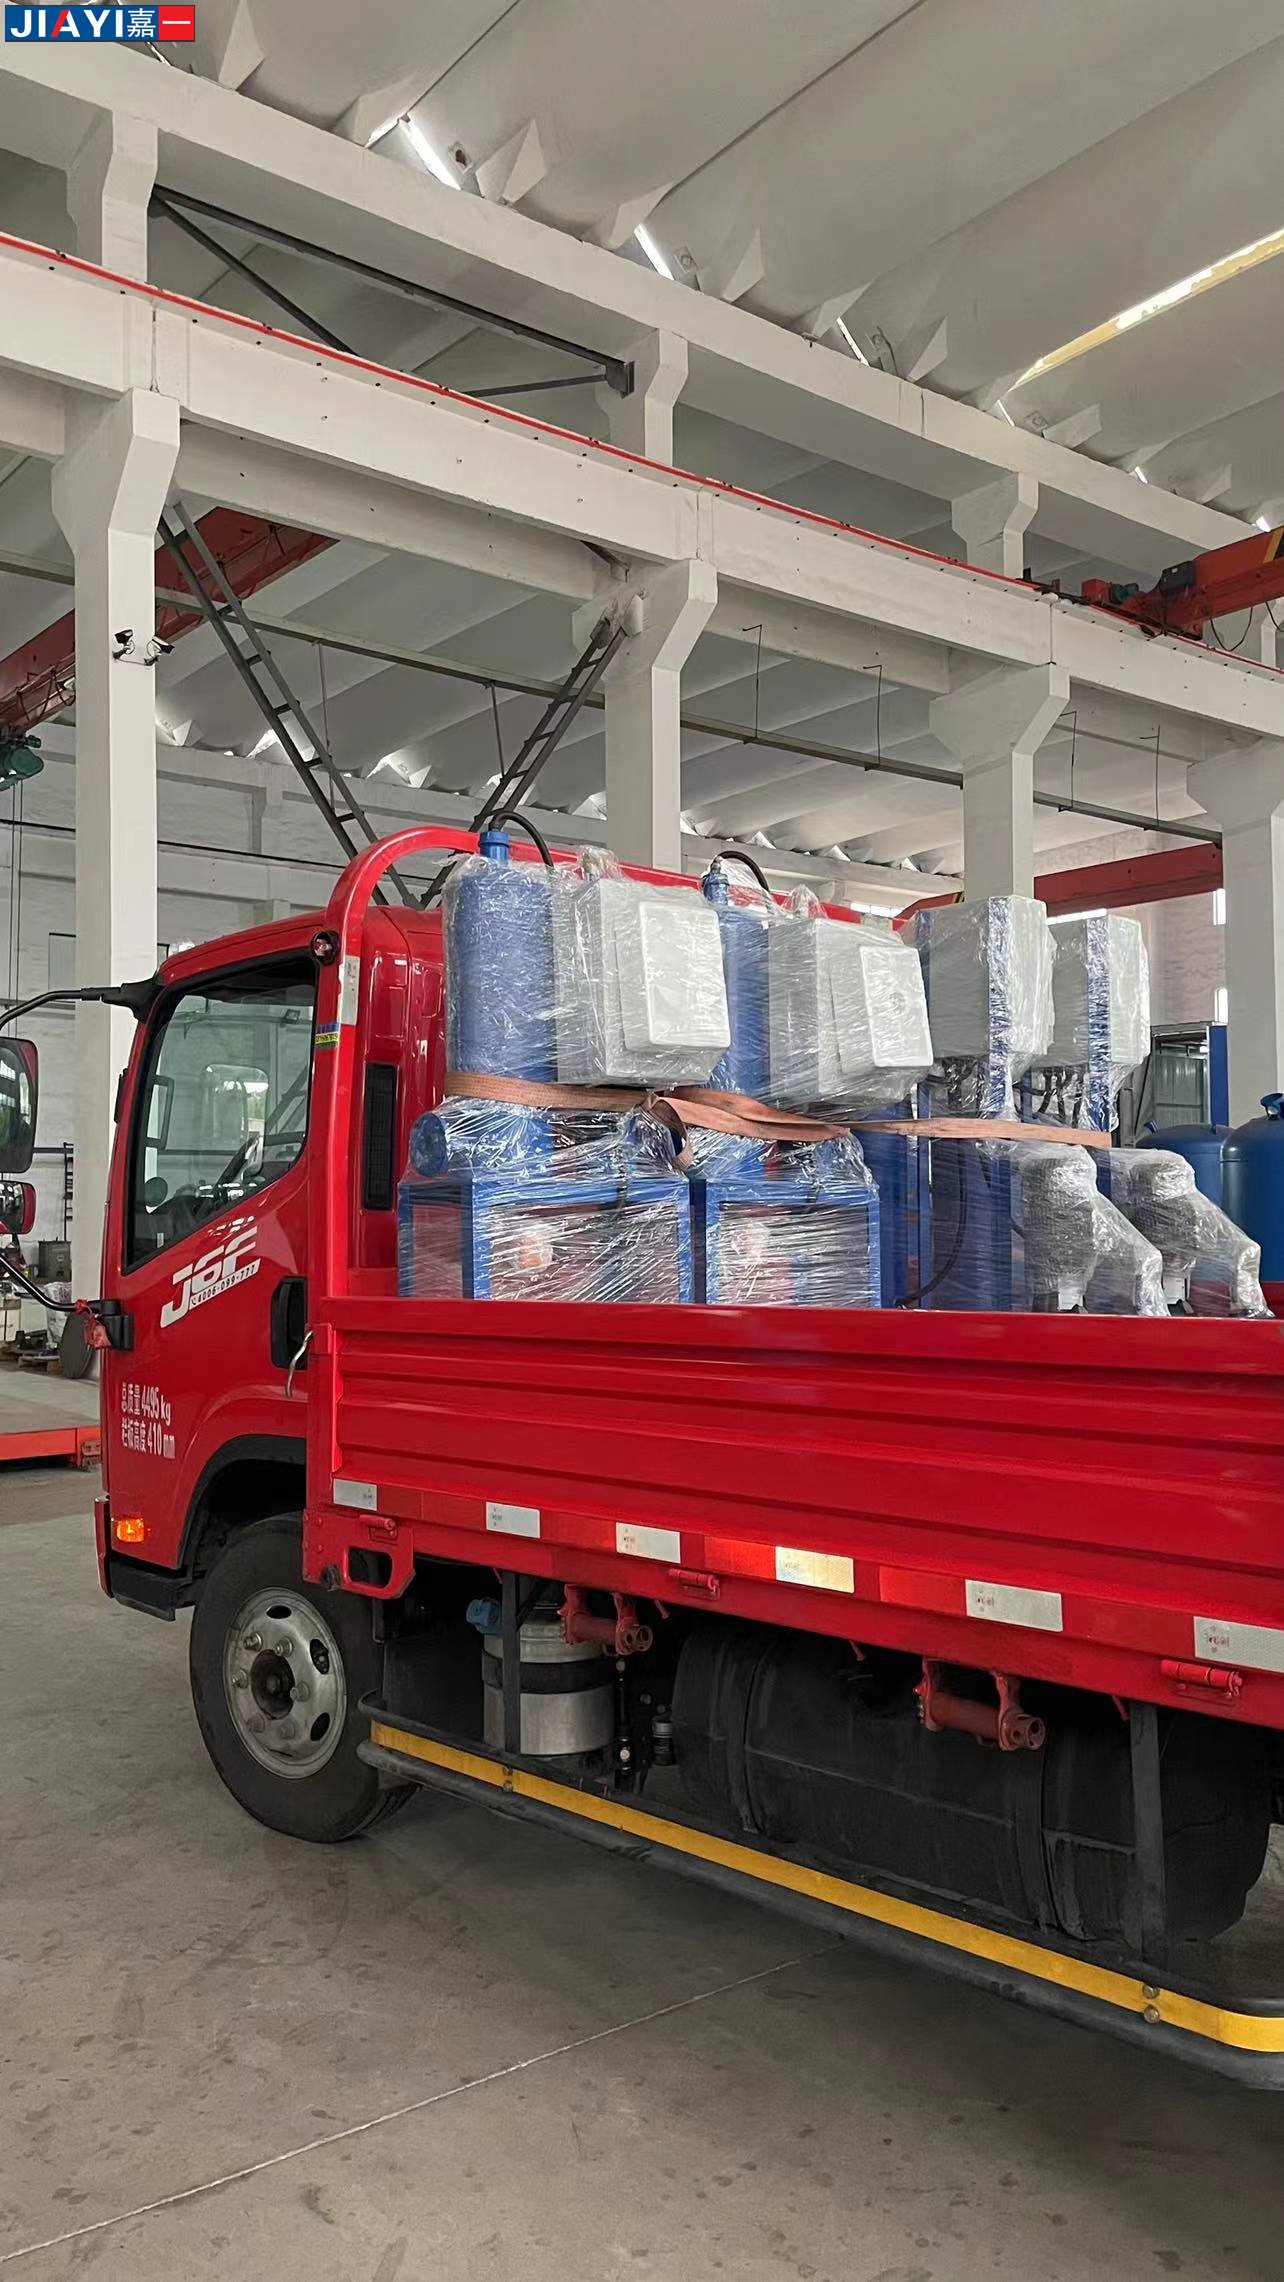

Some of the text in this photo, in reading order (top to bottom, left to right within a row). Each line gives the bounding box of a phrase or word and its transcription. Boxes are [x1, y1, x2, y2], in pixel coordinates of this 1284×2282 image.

[198, 1265, 256, 1303] 4006-099-777
[121, 1381, 171, 1426] 总质量 4495 kg
[147, 1421, 162, 1456] 410
